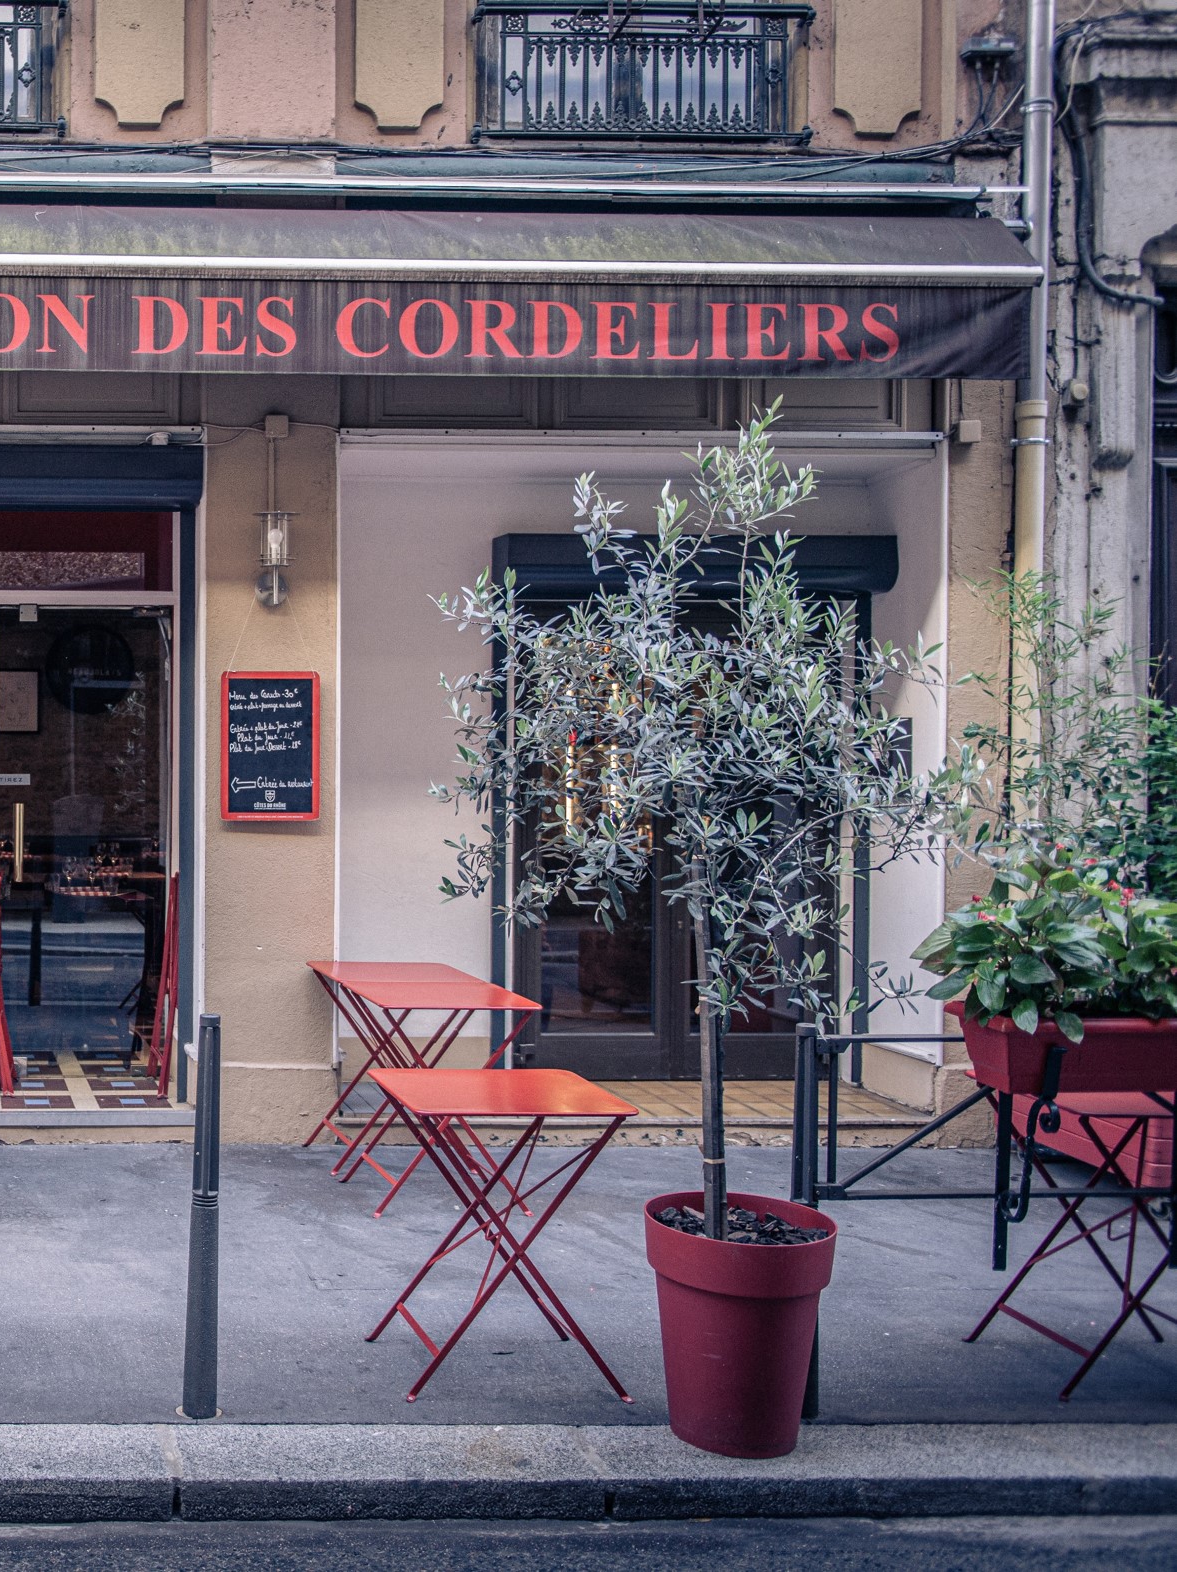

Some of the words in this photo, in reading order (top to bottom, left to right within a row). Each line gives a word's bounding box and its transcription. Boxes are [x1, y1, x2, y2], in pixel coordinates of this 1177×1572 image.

[131, 295, 297, 358] DES
[335, 296, 900, 363] CORDELIERS
[237, 733, 253, 742] Plat
[229, 741, 243, 753] Plat
